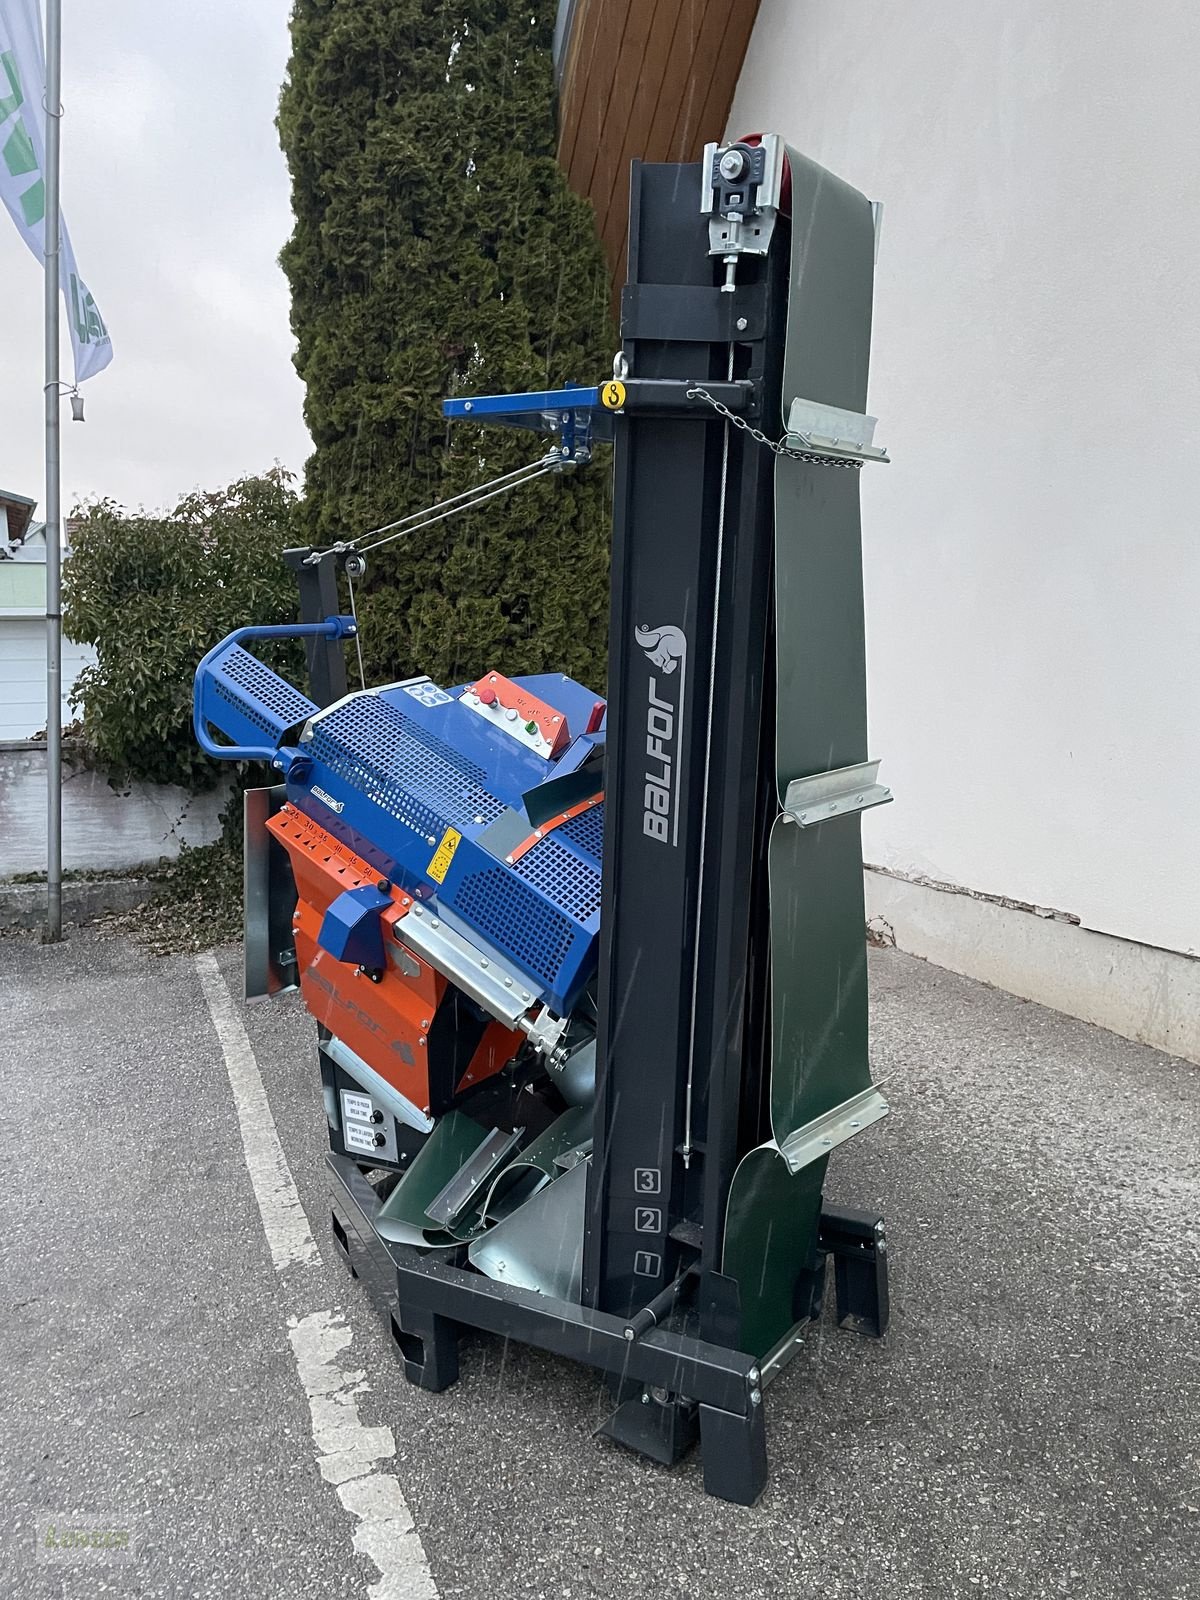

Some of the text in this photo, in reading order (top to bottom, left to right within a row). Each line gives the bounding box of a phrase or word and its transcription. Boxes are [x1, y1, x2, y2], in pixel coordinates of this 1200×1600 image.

[290, 810, 372, 876] 25 30 35 40 45 50
[641, 1171, 654, 1190] 3
[641, 1211, 655, 1230] 2
[644, 1255, 652, 1274] 1
